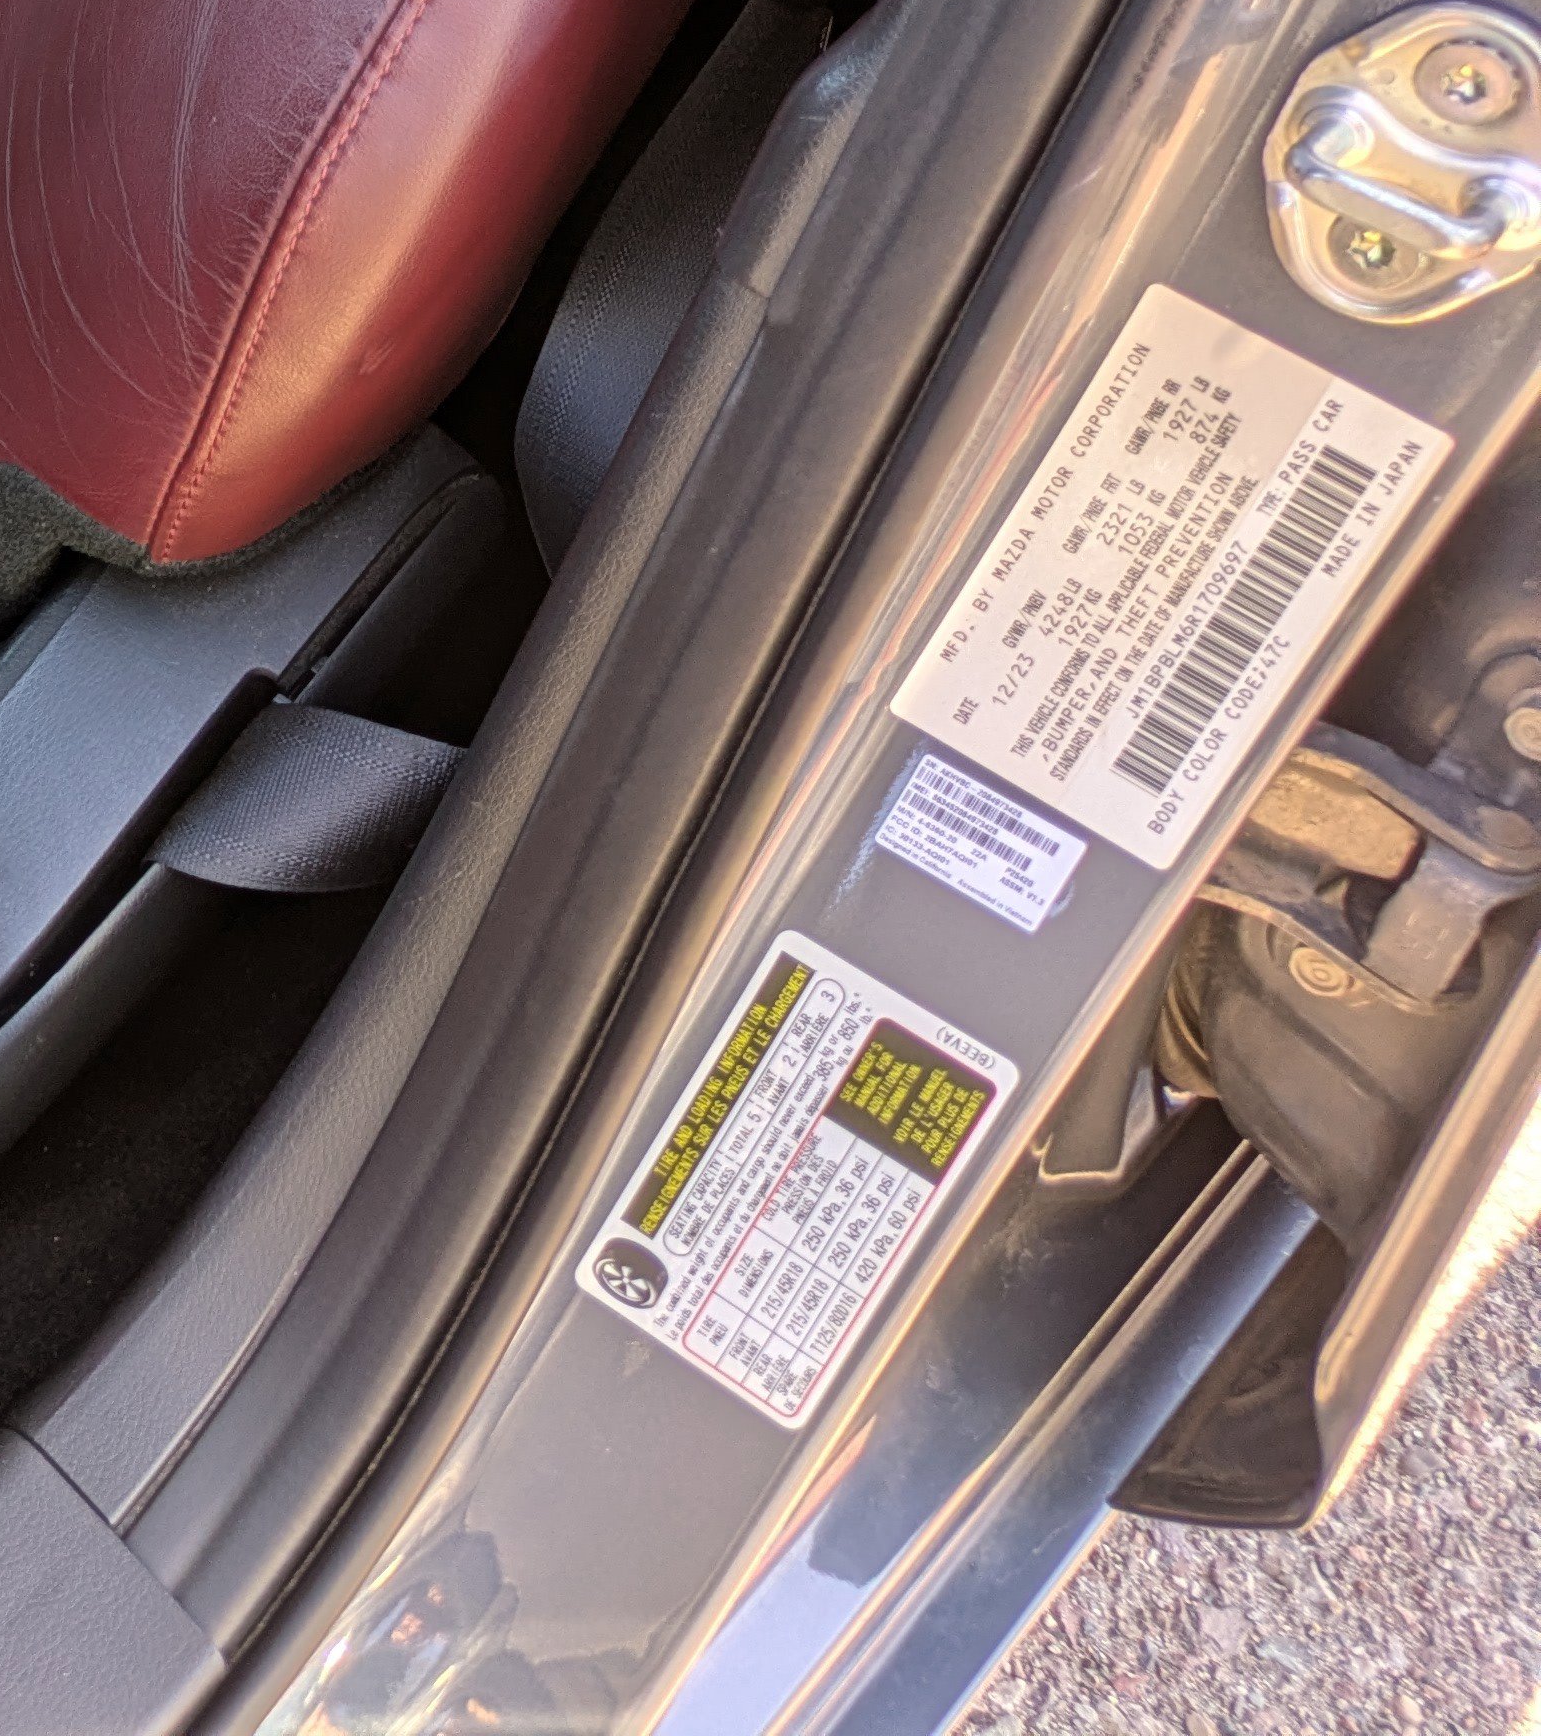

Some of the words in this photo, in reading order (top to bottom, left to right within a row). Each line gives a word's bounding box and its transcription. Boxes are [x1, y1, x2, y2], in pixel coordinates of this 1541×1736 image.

[1159, 397, 1200, 444] 1927
[1189, 374, 1211, 394] LB
[1187, 408, 1221, 445] 874
[1210, 384, 1232, 404] KG
[1209, 411, 1243, 449] SAFETY
[1276, 438, 1318, 485] PASS
[1310, 397, 1345, 434] CAR
[1099, 471, 1123, 494] FRT
[1185, 445, 1221, 487] VEHICLE
[938, 618, 975, 663] MFD.
[971, 587, 995, 613] BY
[990, 524, 1035, 582] MAZDA
[1029, 464, 1074, 521] MOTOR
[1068, 341, 1151, 459] CORPORATION
[1094, 501, 1133, 547] 2321
[1125, 477, 1147, 496] LB
[1114, 510, 1155, 558] 1053
[1145, 488, 1166, 507] KG
[1163, 484, 1196, 520] MOTOR
[1204, 506, 1238, 543] SHOWN
[1318, 531, 1361, 579] MADE
[1354, 499, 1383, 526] IN
[1373, 438, 1424, 497] JAPAN
[1114, 583, 1160, 639] THEFT
[1154, 470, 1234, 579] PREVENTION
[1137, 517, 1175, 560] FEDERAL
[1103, 556, 1150, 614] APPLICABLE
[1162, 539, 1216, 607] MANUFACTURE
[1035, 590, 1075, 638] 4248
[1062, 576, 1083, 595] LB
[1055, 601, 1095, 650] 1927
[1082, 586, 1103, 606] KG
[1090, 610, 1114, 635] ALL
[1153, 604, 1173, 622] OF
[1080, 631, 1101, 650] TO
[1123, 644, 1147, 667] THE
[1136, 618, 1164, 648] DATE
[989, 650, 1036, 709] 12/23
[1049, 646, 1091, 698] CONFORMS
[1112, 664, 1134, 683] ON
[952, 695, 979, 726] DATE
[1024, 694, 1060, 737] VEHICLE
[1083, 712, 1102, 729] IN
[1091, 680, 1123, 716] EFFECT
[1009, 732, 1035, 759] THIS
[1048, 725, 1094, 782] STANDARDS
[1145, 787, 1186, 835] BODY
[1180, 725, 1229, 783] COLOR
[819, 989, 836, 1003] 3
[790, 1011, 812, 1038] REAR
[934, 1024, 997, 1071] (BEEVA)
[781, 1053, 797, 1068] 2
[811, 1057, 835, 1082] 385
[836, 1016, 860, 1041] 850
[875, 1050, 894, 1072] FOR
[638, 1145, 700, 1235] RENSEIGNEMENTS
[691, 1122, 714, 1147] SUR
[706, 1098, 729, 1124] LES
[720, 1063, 750, 1100] PNEUS
[741, 1046, 760, 1065] ET
[752, 1028, 771, 1047] LE
[762, 963, 811, 1029] CHARGEMENT
[653, 1147, 679, 1177] TIRE
[671, 1123, 694, 1148] AND
[686, 1074, 723, 1124] LOADING
[716, 1001, 768, 1074] INFORMATION
[753, 1068, 778, 1099] FRONT
[766, 1076, 790, 1106] AVANT
[839, 1081, 858, 1102] SEE
[877, 1062, 923, 1125] INFORMATION
[728, 1122, 754, 1154] TOTAL
[746, 1110, 762, 1124] 5
[891, 1116, 915, 1144] VOIR
[909, 1127, 926, 1143] DE
[920, 1127, 944, 1155] POUR
[936, 1101, 960, 1129] PLUS
[952, 1085, 969, 1103] DE
[668, 1200, 697, 1239] SEATING
[691, 1157, 723, 1201] CAPACITY
[701, 1199, 714, 1213] DE
[709, 1165, 735, 1199] PLACES
[761, 1197, 782, 1222] COLD
[776, 1174, 795, 1197] TIRE
[789, 1132, 821, 1175] PRESSURE
[781, 1172, 813, 1215] PRESSION
[806, 1153, 824, 1173] DES
[791, 1196, 815, 1225] PNEUS
[814, 1157, 838, 1187] FROID
[800, 1223, 827, 1252] 250
[833, 1176, 856, 1198] 36
[846, 1154, 872, 1181] psi
[826, 1239, 853, 1269] 250
[859, 1192, 882, 1215] 36
[872, 1170, 898, 1196] psi
[852, 1255, 878, 1285] 420
[885, 1208, 908, 1231] 60
[898, 1186, 924, 1212] psi
[733, 1252, 754, 1277] SIZE
[737, 1247, 774, 1298] DIMENSIONS
[759, 1259, 804, 1319] 215/45R18
[784, 1276, 829, 1336] 215/45R18
[696, 1313, 716, 1338] TIRE
[708, 1321, 729, 1347] PNEU
[728, 1331, 750, 1360] FRONT
[752, 1352, 773, 1377] REAR
